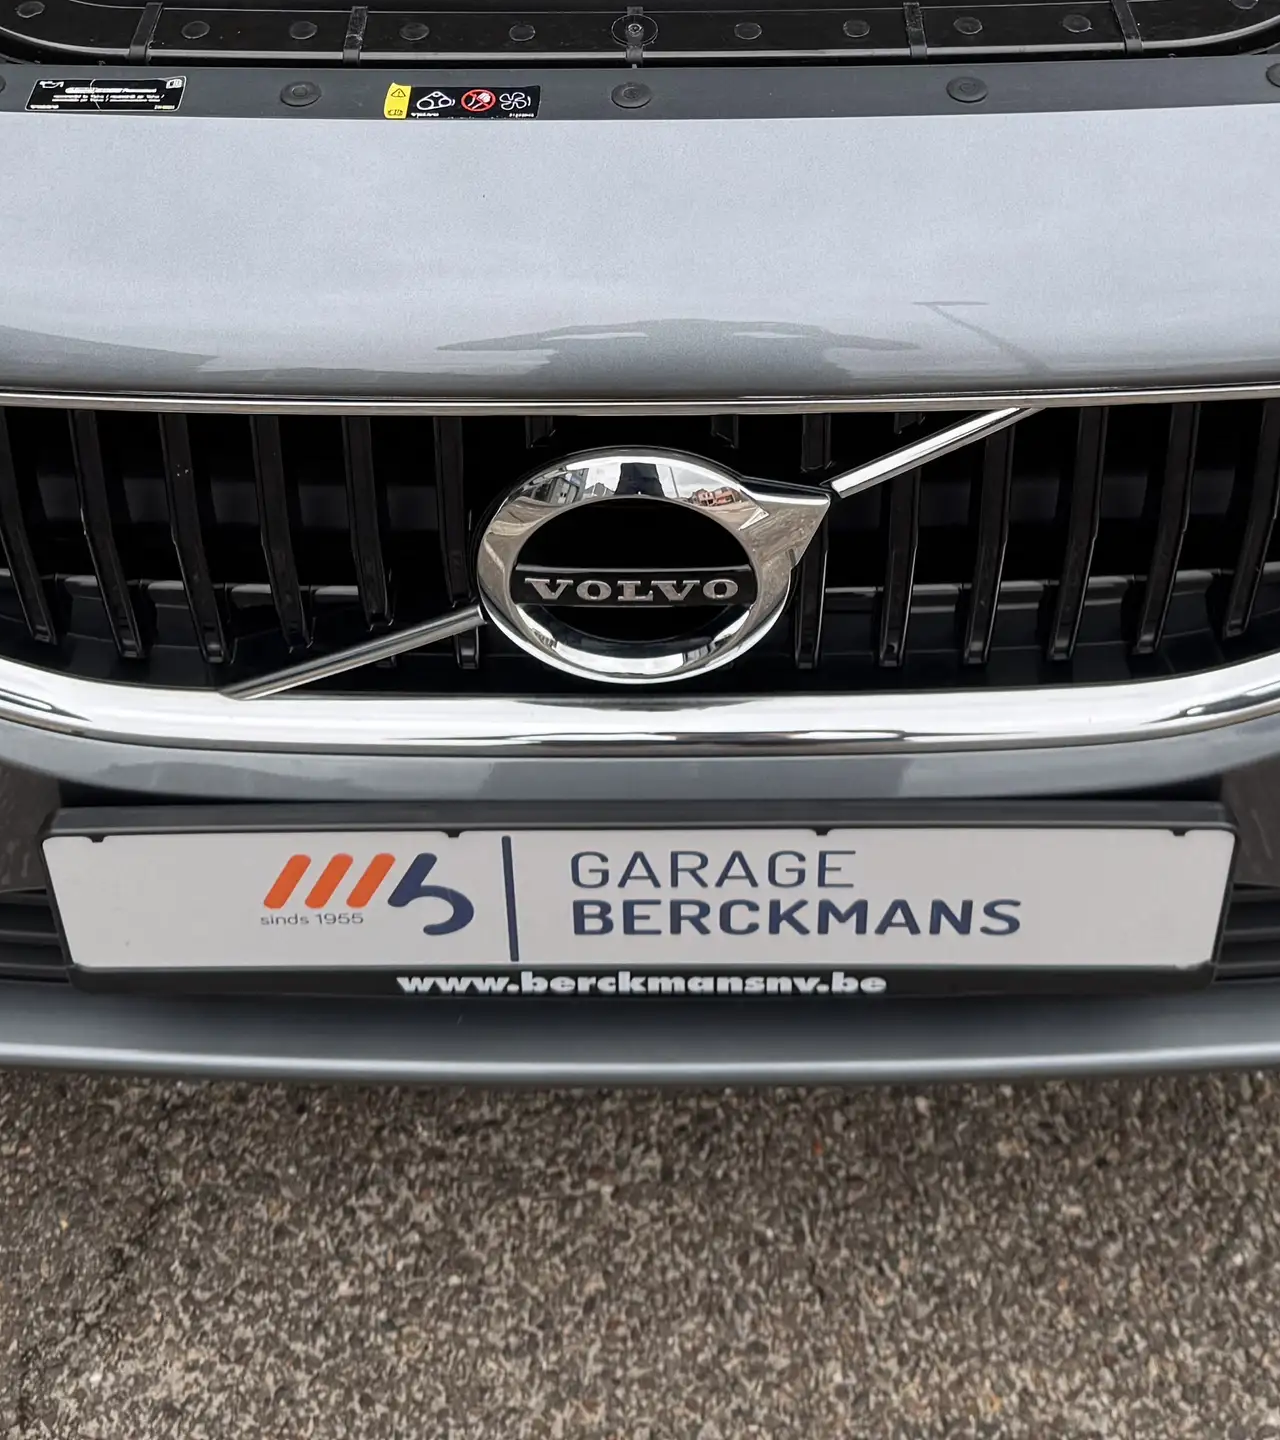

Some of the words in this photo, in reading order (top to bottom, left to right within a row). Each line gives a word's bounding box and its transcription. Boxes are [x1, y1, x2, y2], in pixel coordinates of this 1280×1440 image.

[524, 578, 738, 602] VOLVO
[570, 850, 856, 888] GARAGE
[260, 913, 309, 926] sinds
[315, 913, 364, 925] 1955
[572, 898, 1021, 935] BERCKMANS
[396, 971, 887, 994] www.berckmansnv.be
